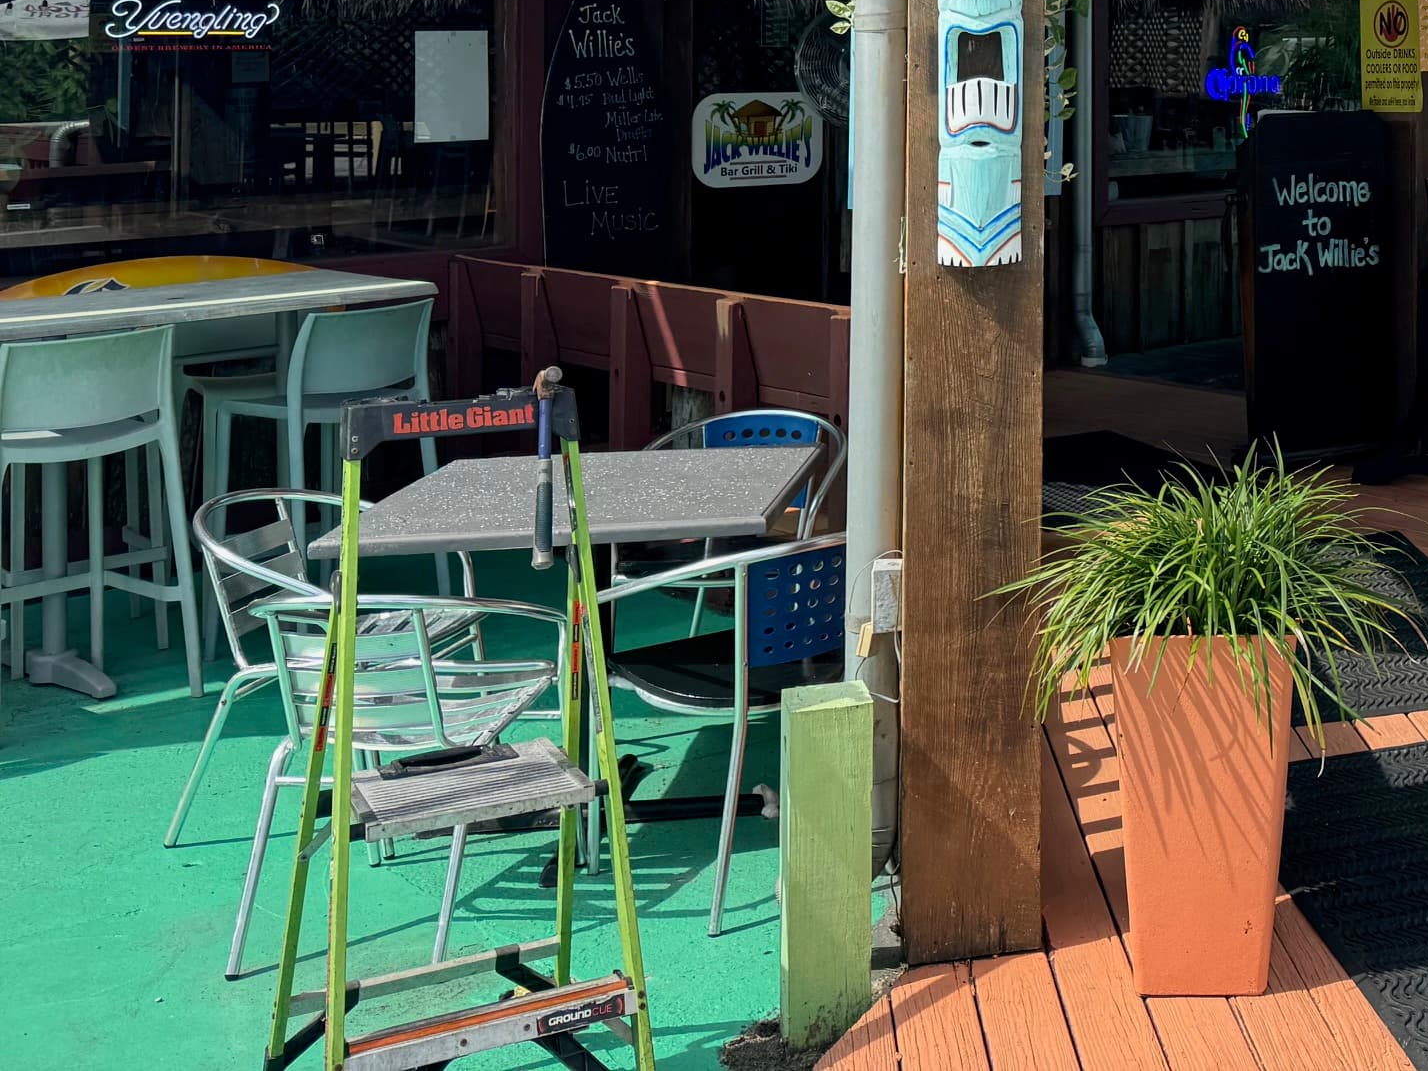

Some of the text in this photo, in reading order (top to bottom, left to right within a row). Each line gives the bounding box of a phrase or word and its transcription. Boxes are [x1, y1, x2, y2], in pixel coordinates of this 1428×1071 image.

[578, 3, 626, 25] Jack
[1379, 11, 1407, 36] NO
[568, 29, 636, 59] Willie's
[1366, 49, 1392, 59] Outside
[1366, 63, 1392, 74] COOLERS
[1393, 63, 1401, 74] OR
[1402, 63, 1418, 74] FOOD
[1205, 68, 1282, 101] Corona
[704, 119, 742, 174] JACK
[721, 164, 798, 176] Bar Grill & Tiki
[1272, 173, 1371, 207] Welcome
[1302, 209, 1331, 237] to
[1257, 237, 1380, 276] Jack Willie's
[393, 403, 535, 434] Little Giant
